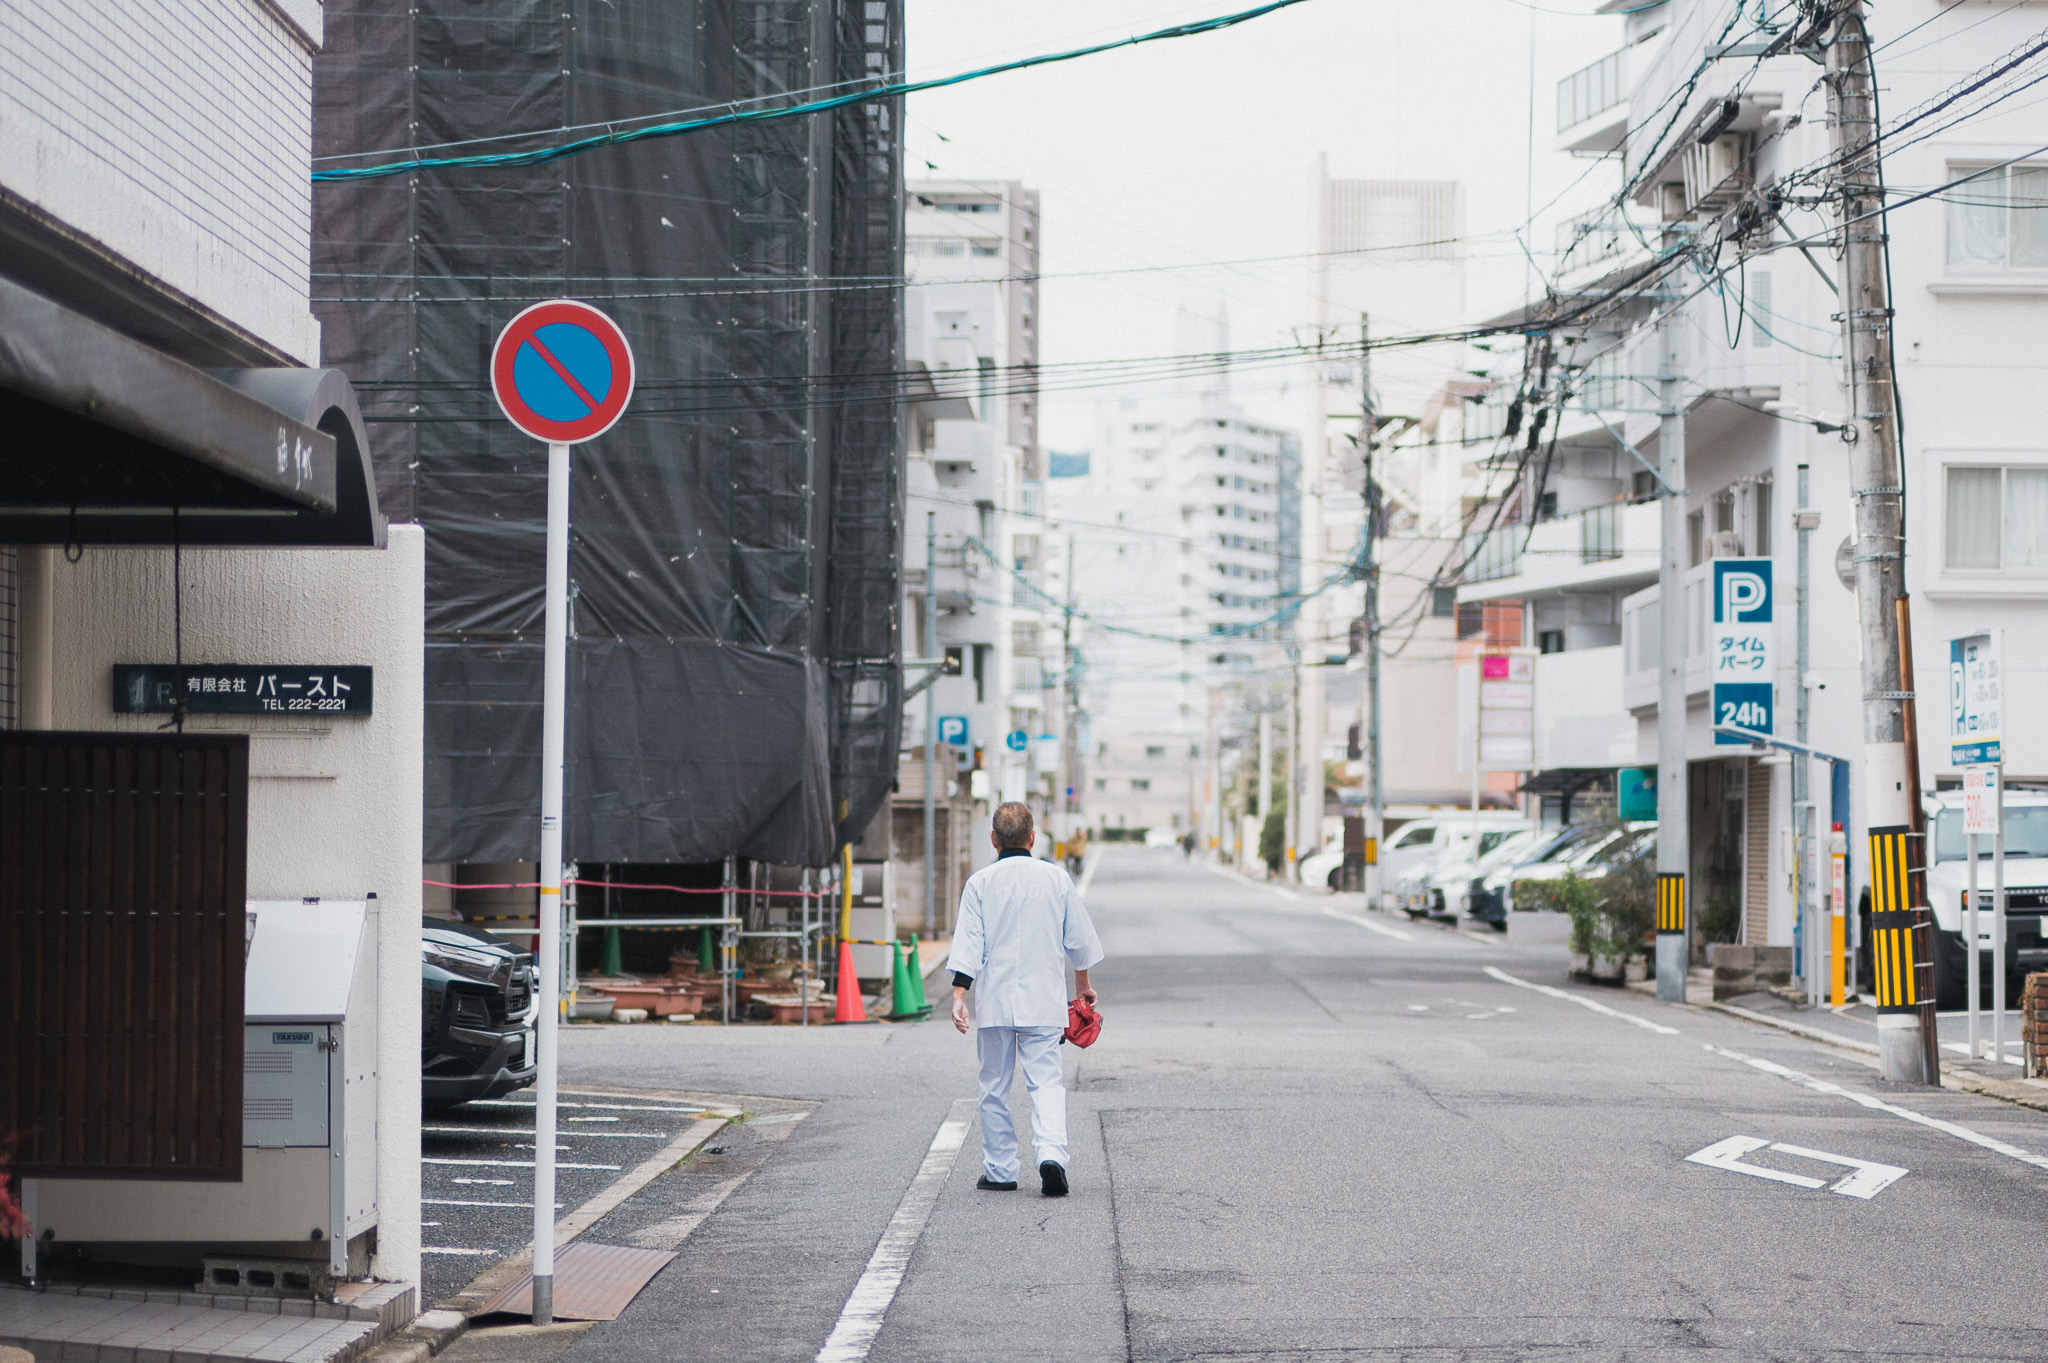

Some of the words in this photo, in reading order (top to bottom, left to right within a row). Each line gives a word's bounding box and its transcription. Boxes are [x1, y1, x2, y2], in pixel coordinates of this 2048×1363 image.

[1722, 572, 1767, 623] P
[1719, 637, 1766, 651] タイム
[1719, 655, 1766, 670] パーク
[187, 677, 247, 693] 有限会社
[256, 674, 351, 697] バースト
[262, 698, 285, 710] TEL
[288, 698, 346, 710] 222-2221
[1721, 701, 1767, 726] 24h
[942, 720, 964, 743] P
